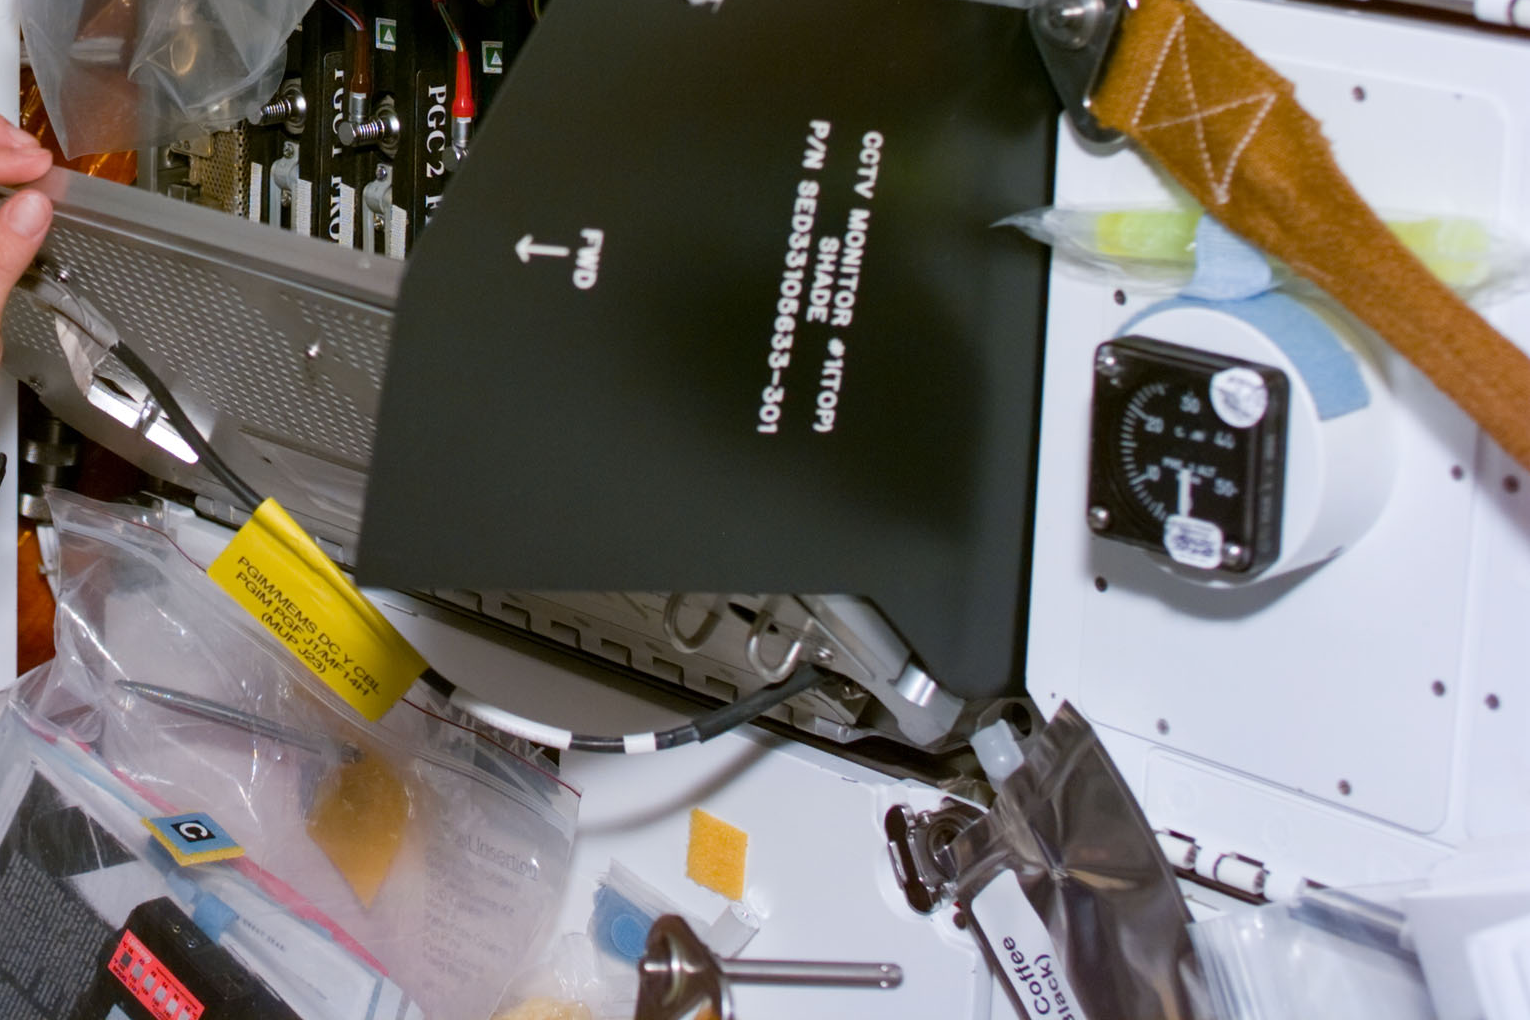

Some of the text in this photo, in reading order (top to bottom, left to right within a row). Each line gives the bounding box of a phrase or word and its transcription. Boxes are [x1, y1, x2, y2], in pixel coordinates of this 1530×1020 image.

[426, 84, 447, 154] PGC
[801, 120, 831, 170] P/N
[426, 161, 446, 178] 2
[853, 130, 884, 199] CCTV
[571, 228, 604, 290] FWD
[806, 236, 841, 323] SHADE
[829, 208, 871, 327] MONITOR
[235, 571, 371, 697] PGIM PGF J1/MF14H
[237, 556, 381, 695] PGIM/MEMS DC Y CBL
[261, 612, 327, 674] (MUP J23)
[178, 821, 208, 839] C
[1003, 936, 1051, 1016] Coffee
